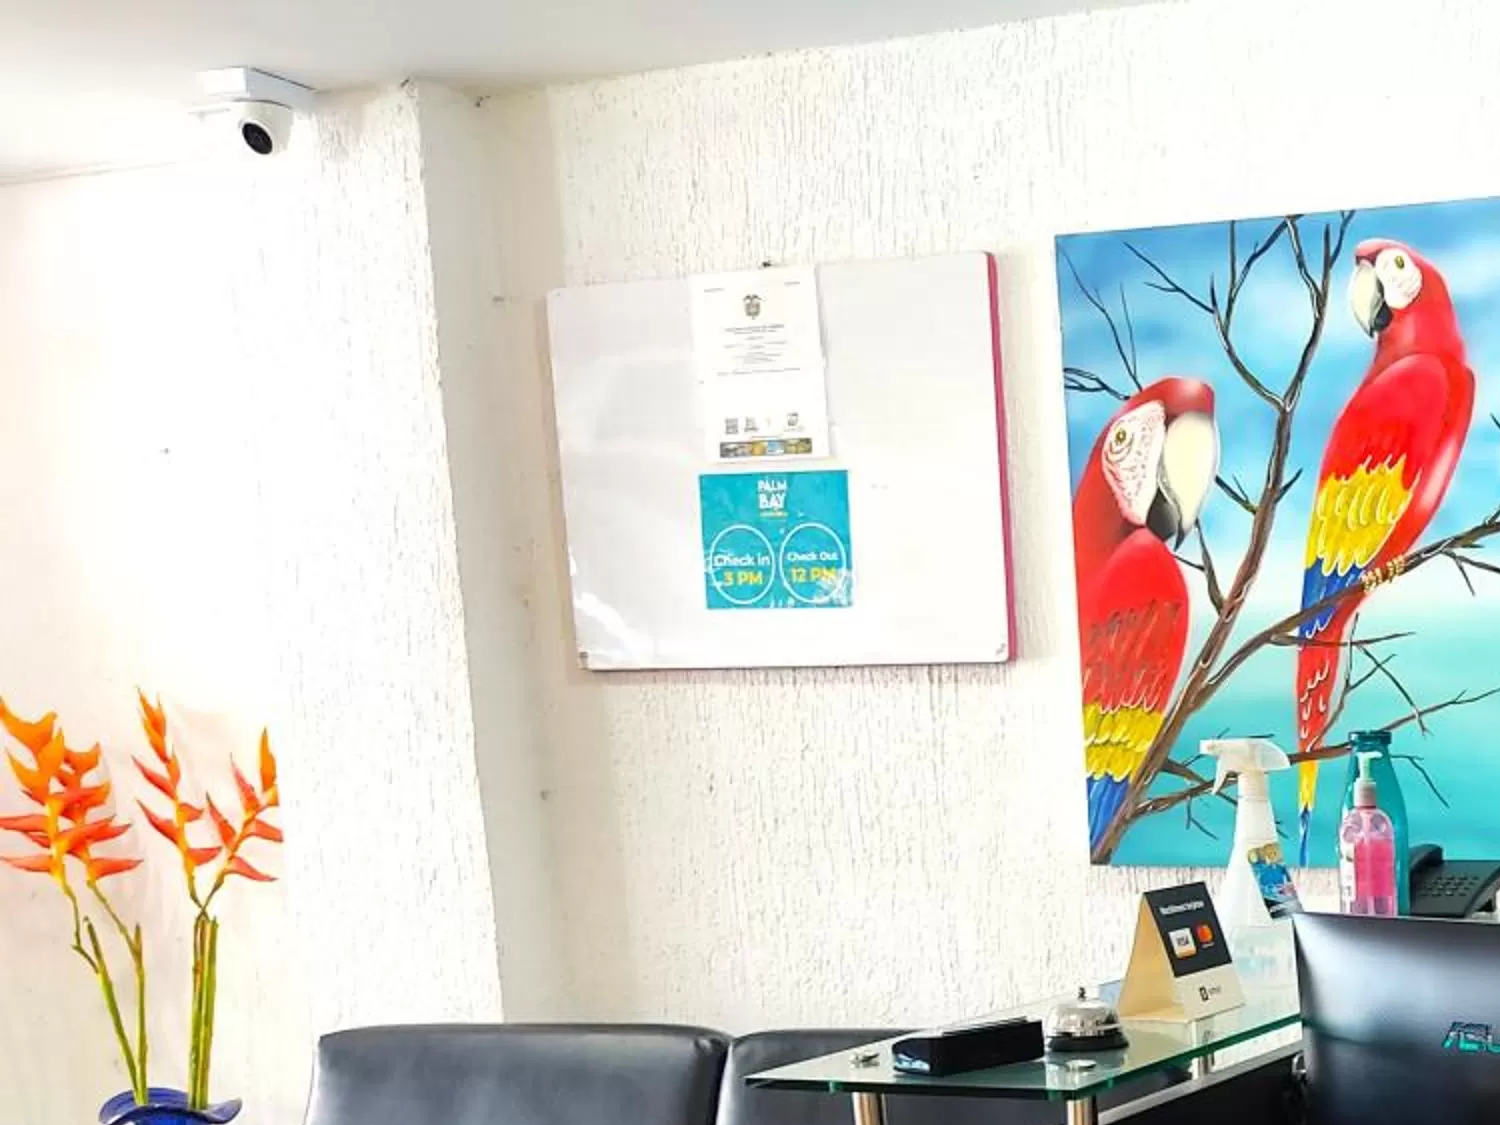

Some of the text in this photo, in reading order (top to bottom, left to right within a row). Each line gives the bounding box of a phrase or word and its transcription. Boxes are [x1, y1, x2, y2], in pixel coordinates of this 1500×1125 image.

[757, 480, 787, 492] PALM
[758, 494, 786, 509] BAY
[714, 554, 753, 566] Check
[787, 552, 838, 561] Check Out
[724, 571, 763, 585] 3 PM
[791, 567, 837, 582] 12 PM
